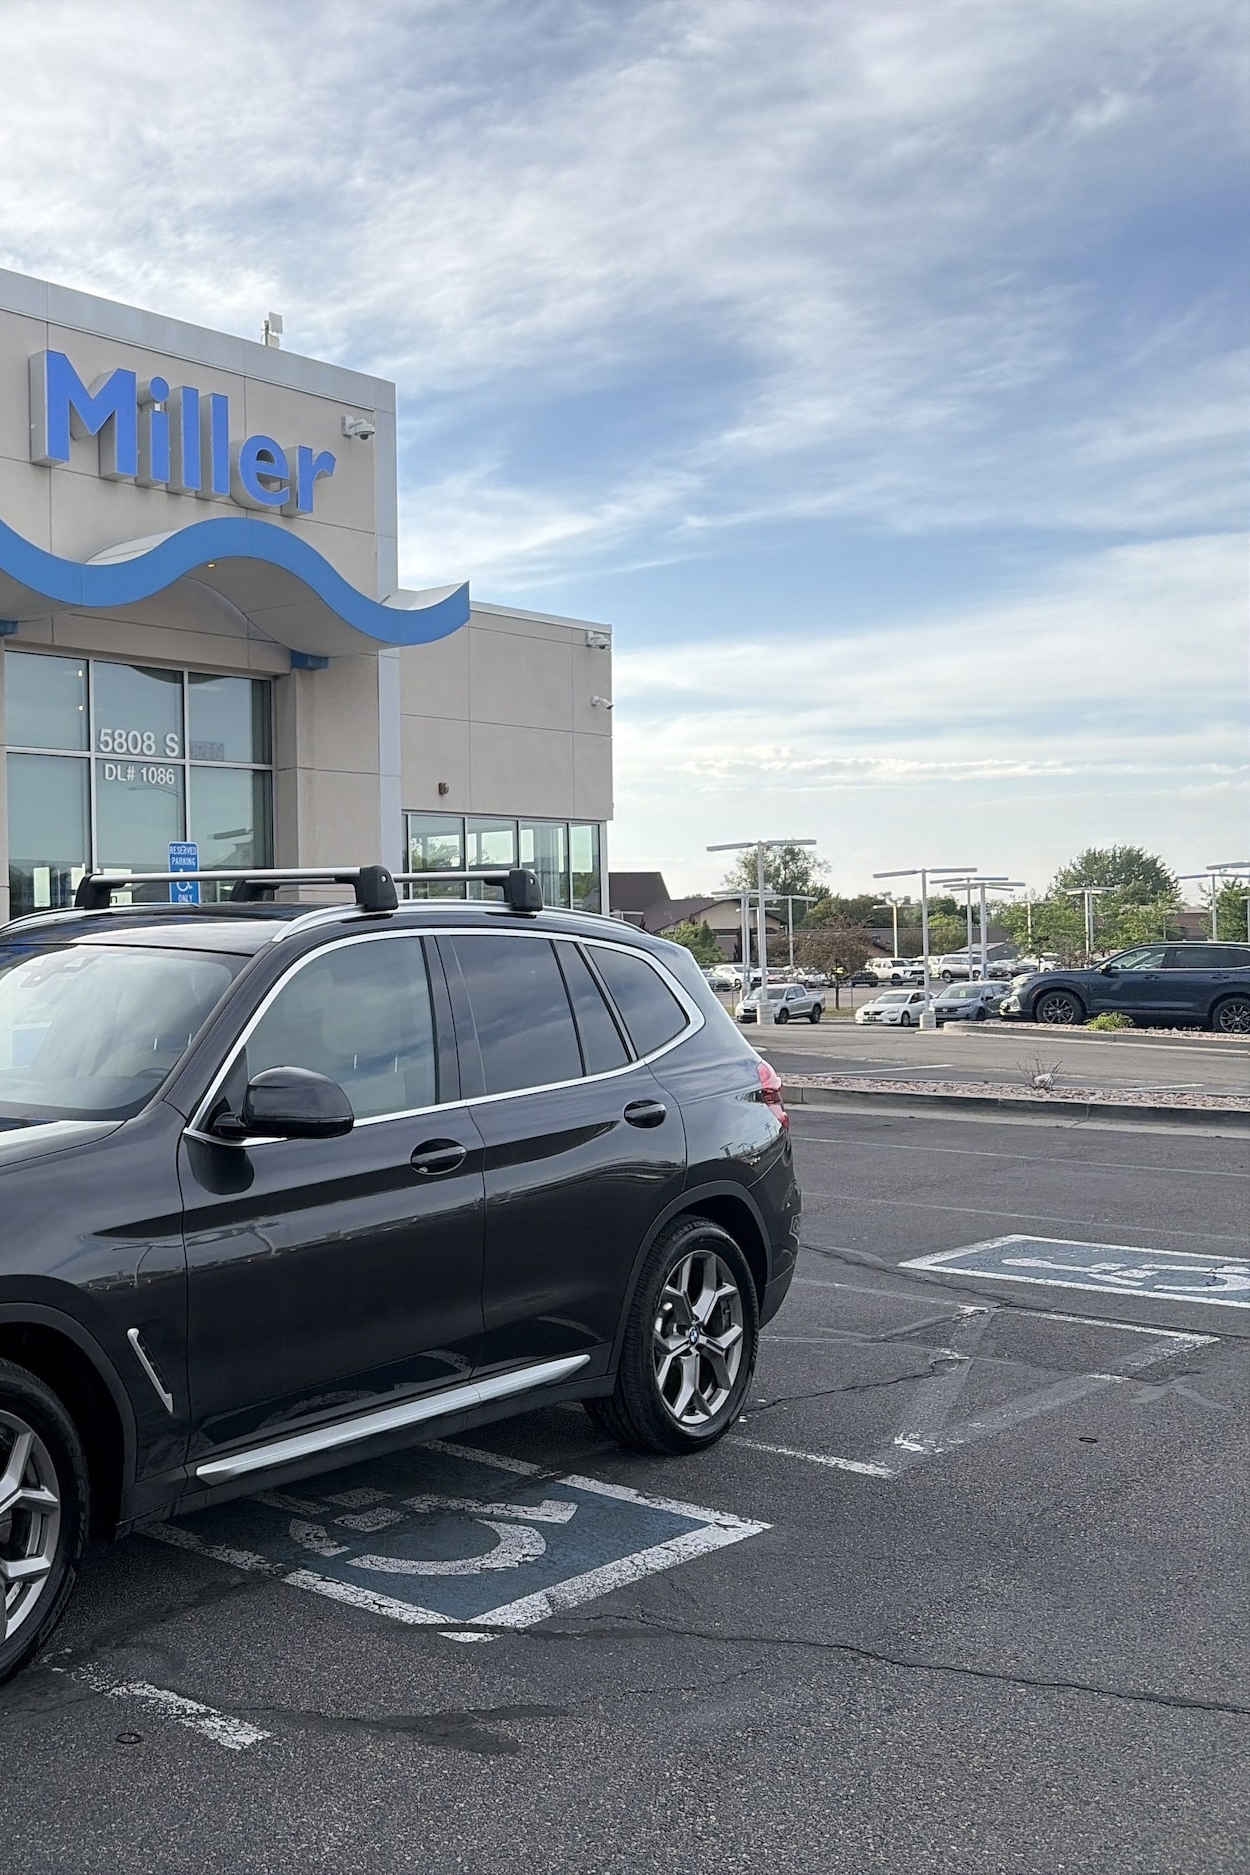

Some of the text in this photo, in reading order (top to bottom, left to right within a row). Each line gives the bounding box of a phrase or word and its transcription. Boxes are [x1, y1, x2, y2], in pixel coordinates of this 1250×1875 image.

[38, 349, 337, 515] Miller
[99, 727, 180, 758] 5808 S
[104, 763, 175, 785] DL# 1086
[169, 845, 197, 856] RESERVED
[171, 857, 196, 866] PARKING
[177, 893, 194, 904] ONLY
